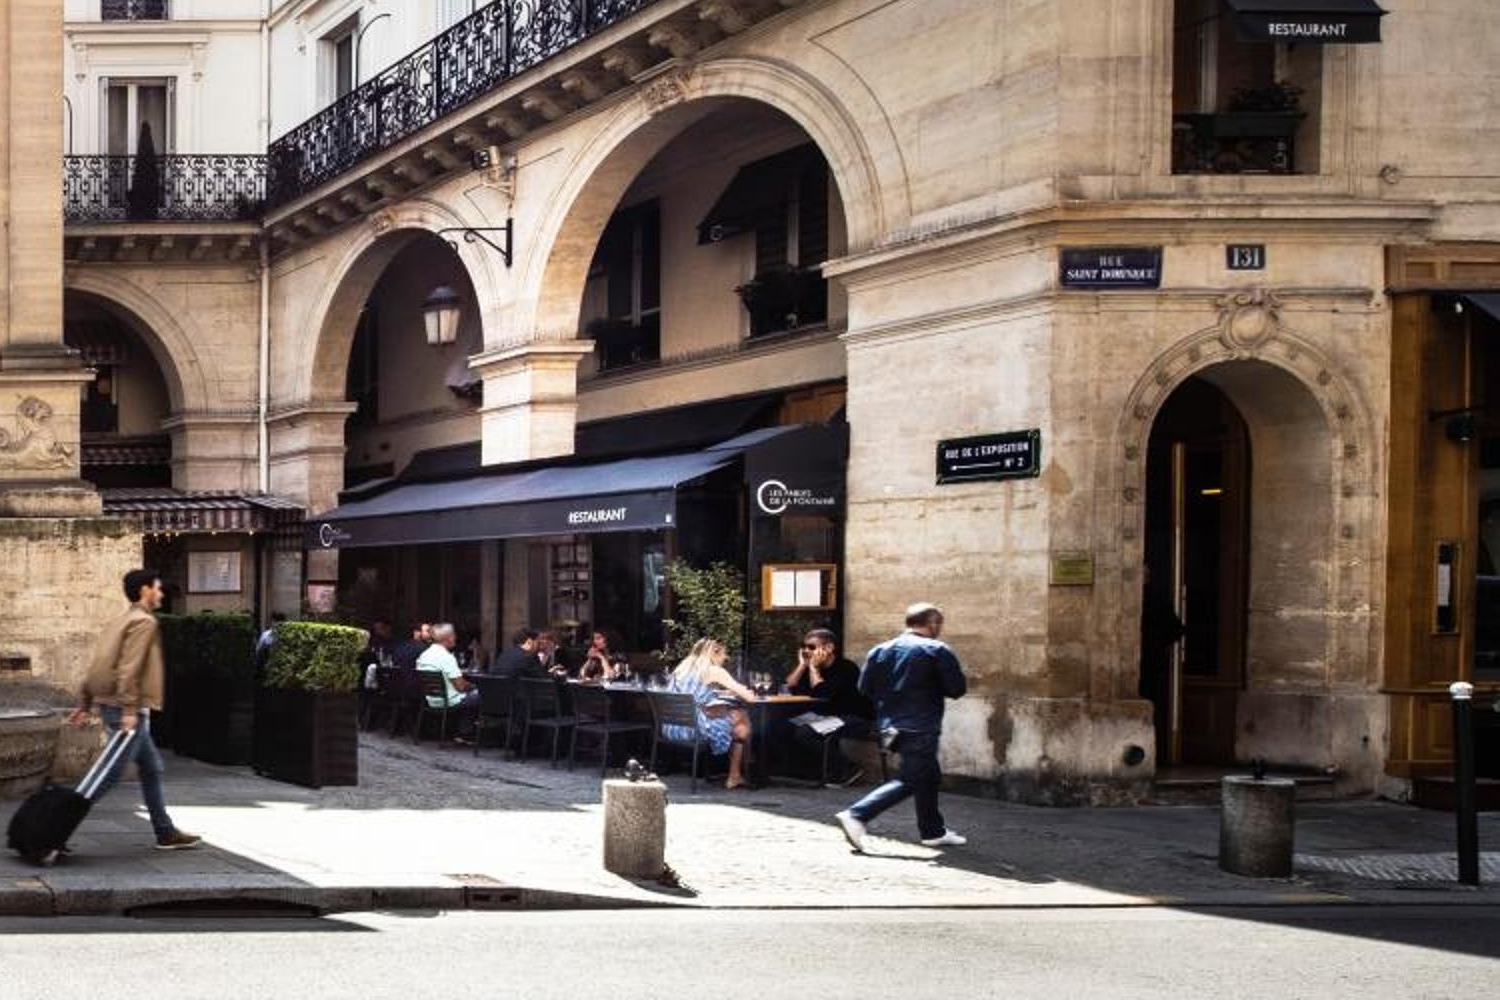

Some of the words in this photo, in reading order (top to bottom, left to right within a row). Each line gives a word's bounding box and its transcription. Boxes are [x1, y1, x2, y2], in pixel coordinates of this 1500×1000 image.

[1268, 23, 1347, 36] RESTAURANT
[1100, 255, 1124, 267] RUE
[1232, 247, 1260, 267] 131
[1067, 269, 1099, 280] SAINT
[945, 449, 959, 459] RUE
[568, 507, 627, 524] RESTAURANT
